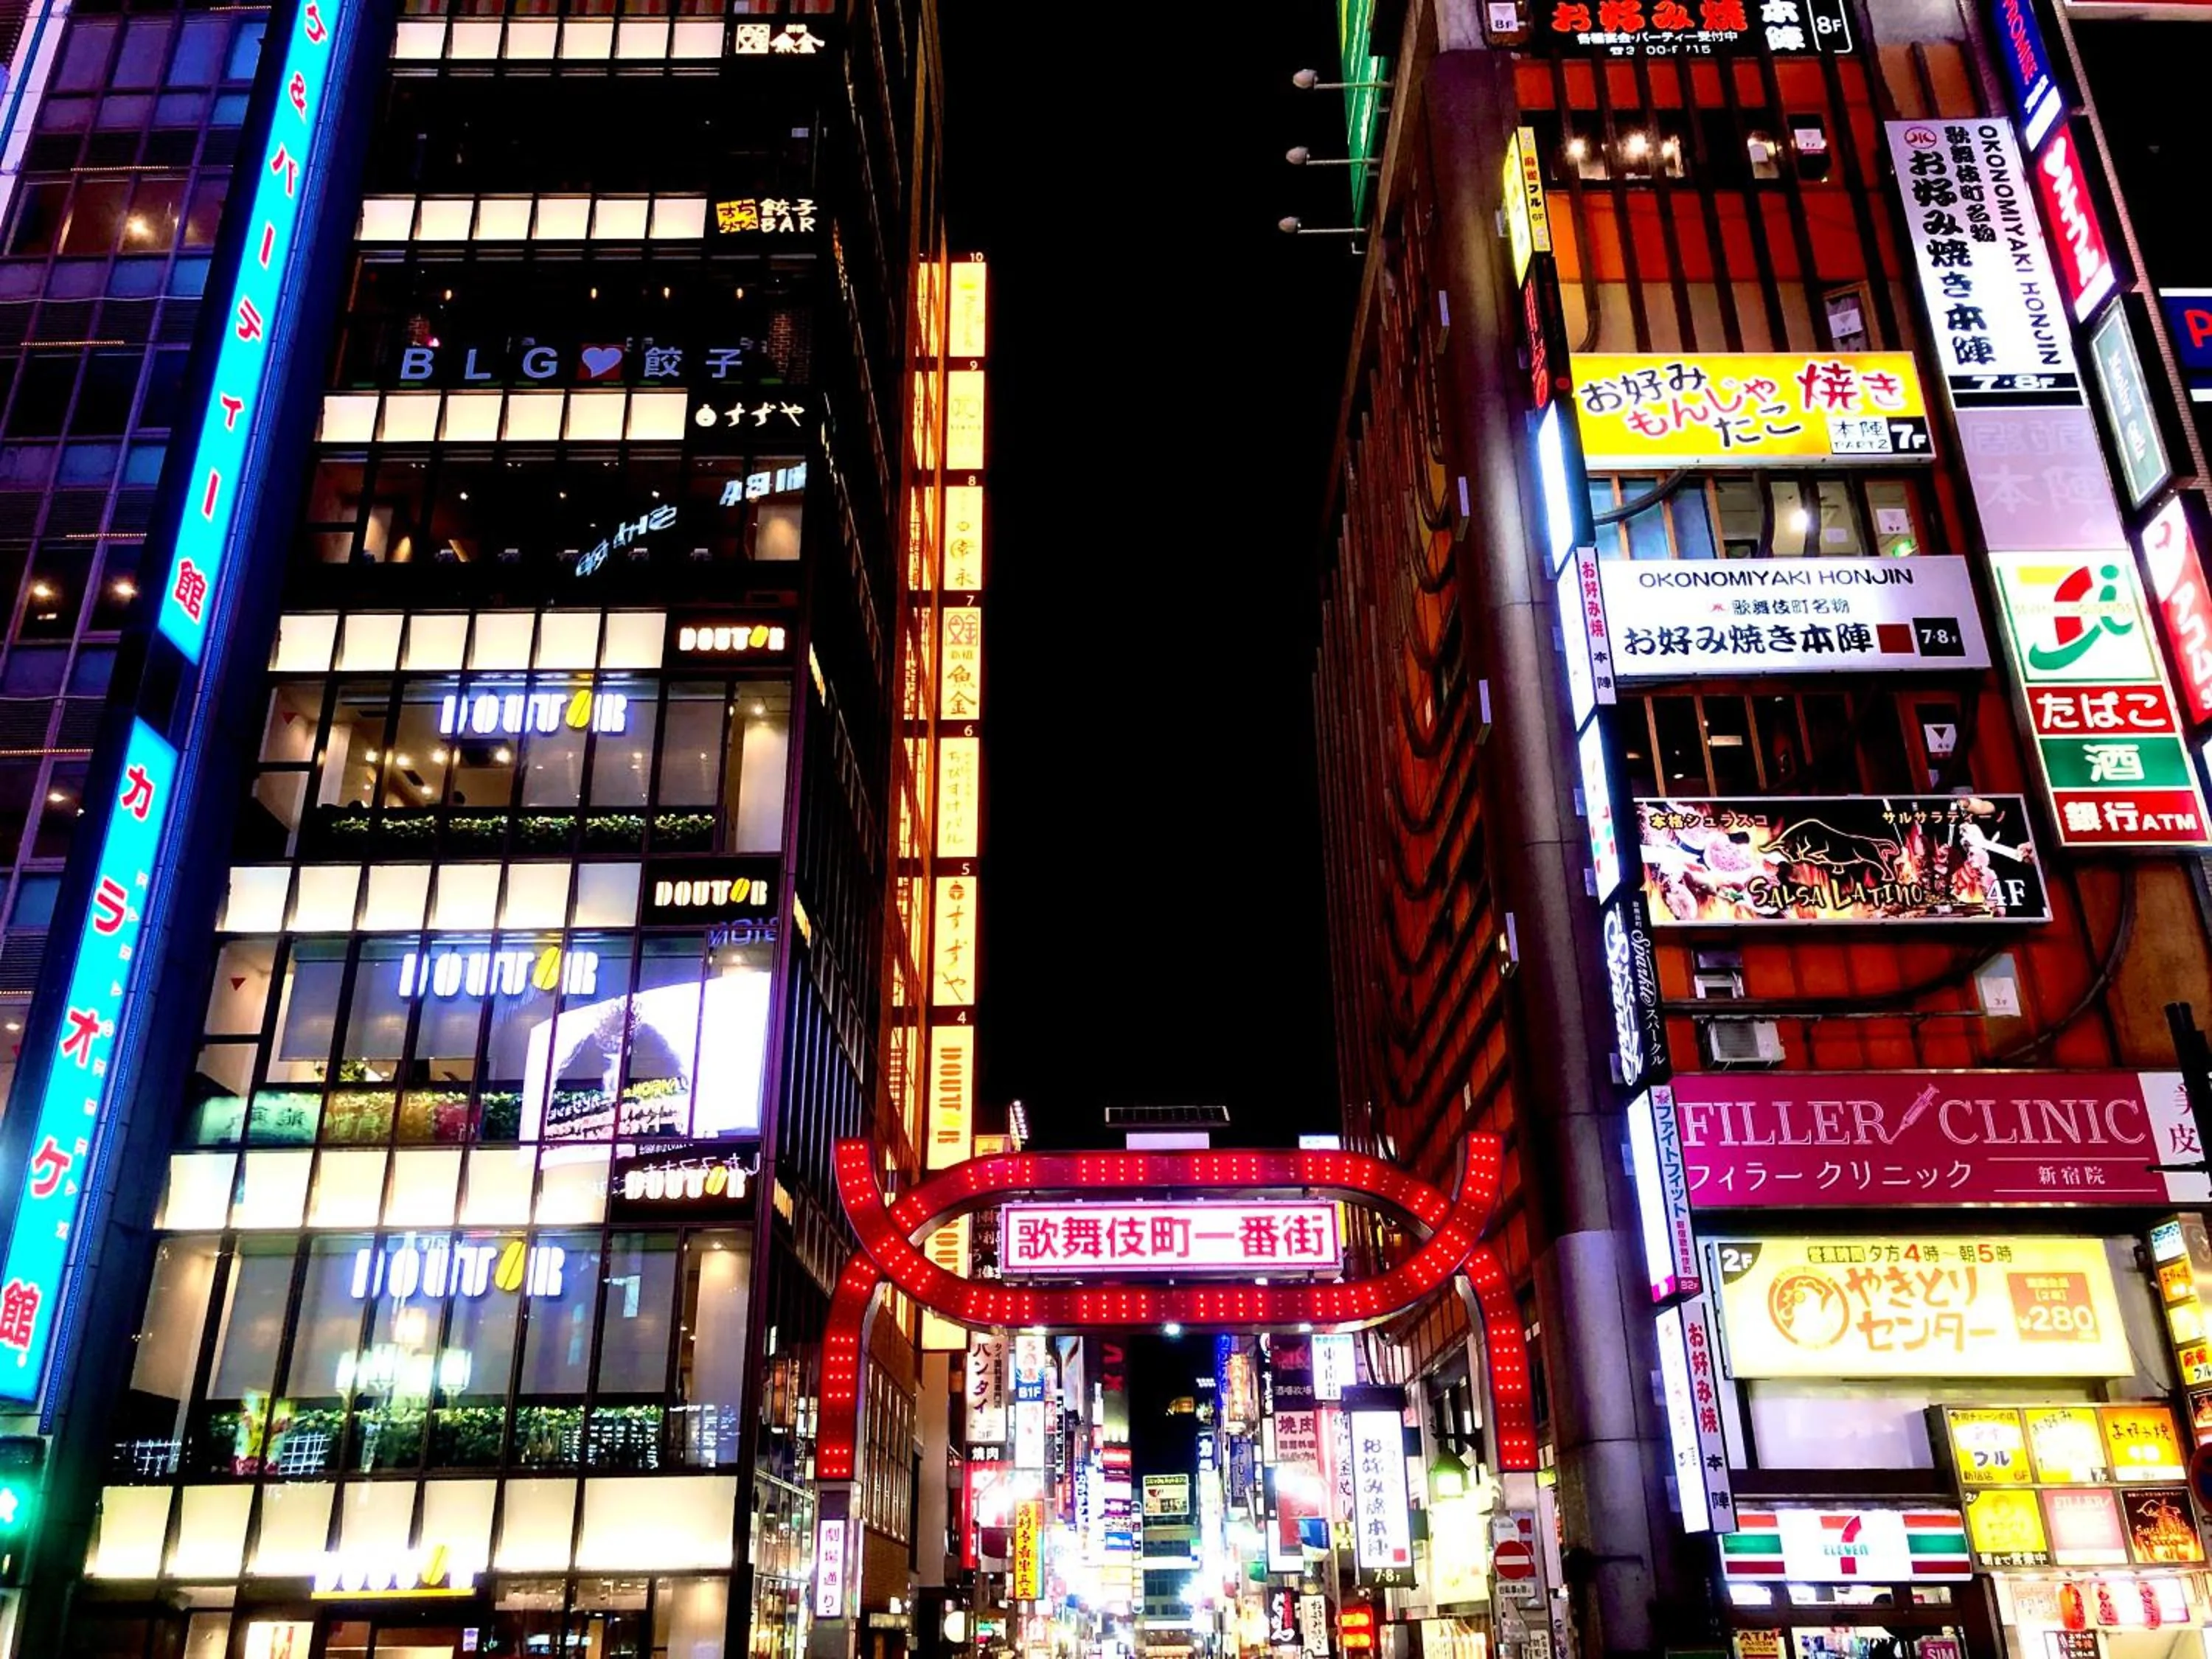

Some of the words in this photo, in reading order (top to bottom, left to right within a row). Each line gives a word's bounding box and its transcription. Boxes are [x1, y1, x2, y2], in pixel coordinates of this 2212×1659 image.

[1552, 0, 1748, 32] お好み焼
[1817, 16, 1842, 35] 8F
[761, 217, 816, 233] BAR
[970, 251, 984, 262] 10
[1908, 150, 1997, 366] お好み焼き本陣
[1978, 125, 2035, 274] OKONOMIYAKI
[2020, 282, 2062, 366] HONJIN
[970, 361, 978, 371] 9
[1581, 364, 1706, 412] お好み
[1797, 362, 1902, 411] 焼き
[1627, 378, 1776, 437] もんじゃ
[1714, 405, 1801, 448] たこ
[1834, 421, 1883, 439] 本陣
[1891, 424, 1926, 450] 7F
[968, 476, 976, 487] 8
[1638, 569, 1812, 588] OKONOMIYAKI
[1819, 568, 1914, 585] HONJIN
[967, 595, 975, 606] 7
[1582, 561, 1605, 638] お好み焼
[1733, 599, 1851, 616] 歌舞伎町名物
[678, 624, 785, 652] DOUTOR
[1624, 622, 1874, 656] お好み焼き本陣
[1593, 651, 1613, 690] 本陣
[439, 689, 628, 735] DOUTOR
[2037, 692, 2168, 729] たばこ
[964, 726, 973, 736] 6
[2083, 744, 2145, 783] 酒
[1649, 813, 1768, 829] 本格シュラスコ
[961, 863, 970, 874] 5
[654, 877, 768, 907] DOUTOR
[1986, 880, 2026, 906] 4F
[943, 904, 966, 1002] すずや
[1631, 929, 1657, 1007] Sparkle
[399, 945, 599, 997] DOUTOR
[957, 1011, 967, 1024] 4
[1645, 1009, 1666, 1066] スパークル
[0, 765, 155, 1352] カラオケ館
[1677, 1100, 1891, 1147] FILLER
[1938, 1098, 2147, 1147] CLINIC
[625, 1165, 746, 1200] DOUTOR
[1688, 1161, 1804, 1192] フィラー
[1816, 1159, 1973, 1192] クリニック
[2037, 1166, 2107, 1186] 新宿院
[1017, 1214, 1325, 1259] 歌舞伎町一番街
[350, 1240, 566, 1298] DOUTOR
[1721, 1248, 1753, 1273] 2F
[1846, 1267, 1978, 1310] やきとり
[1857, 1312, 1997, 1352] センター
[1018, 1387, 1043, 1399] B1F
[1974, 1450, 2010, 1467] フル
[1705, 1453, 1731, 1510] 本陣
[1739, 1631, 1778, 1641] ATM
